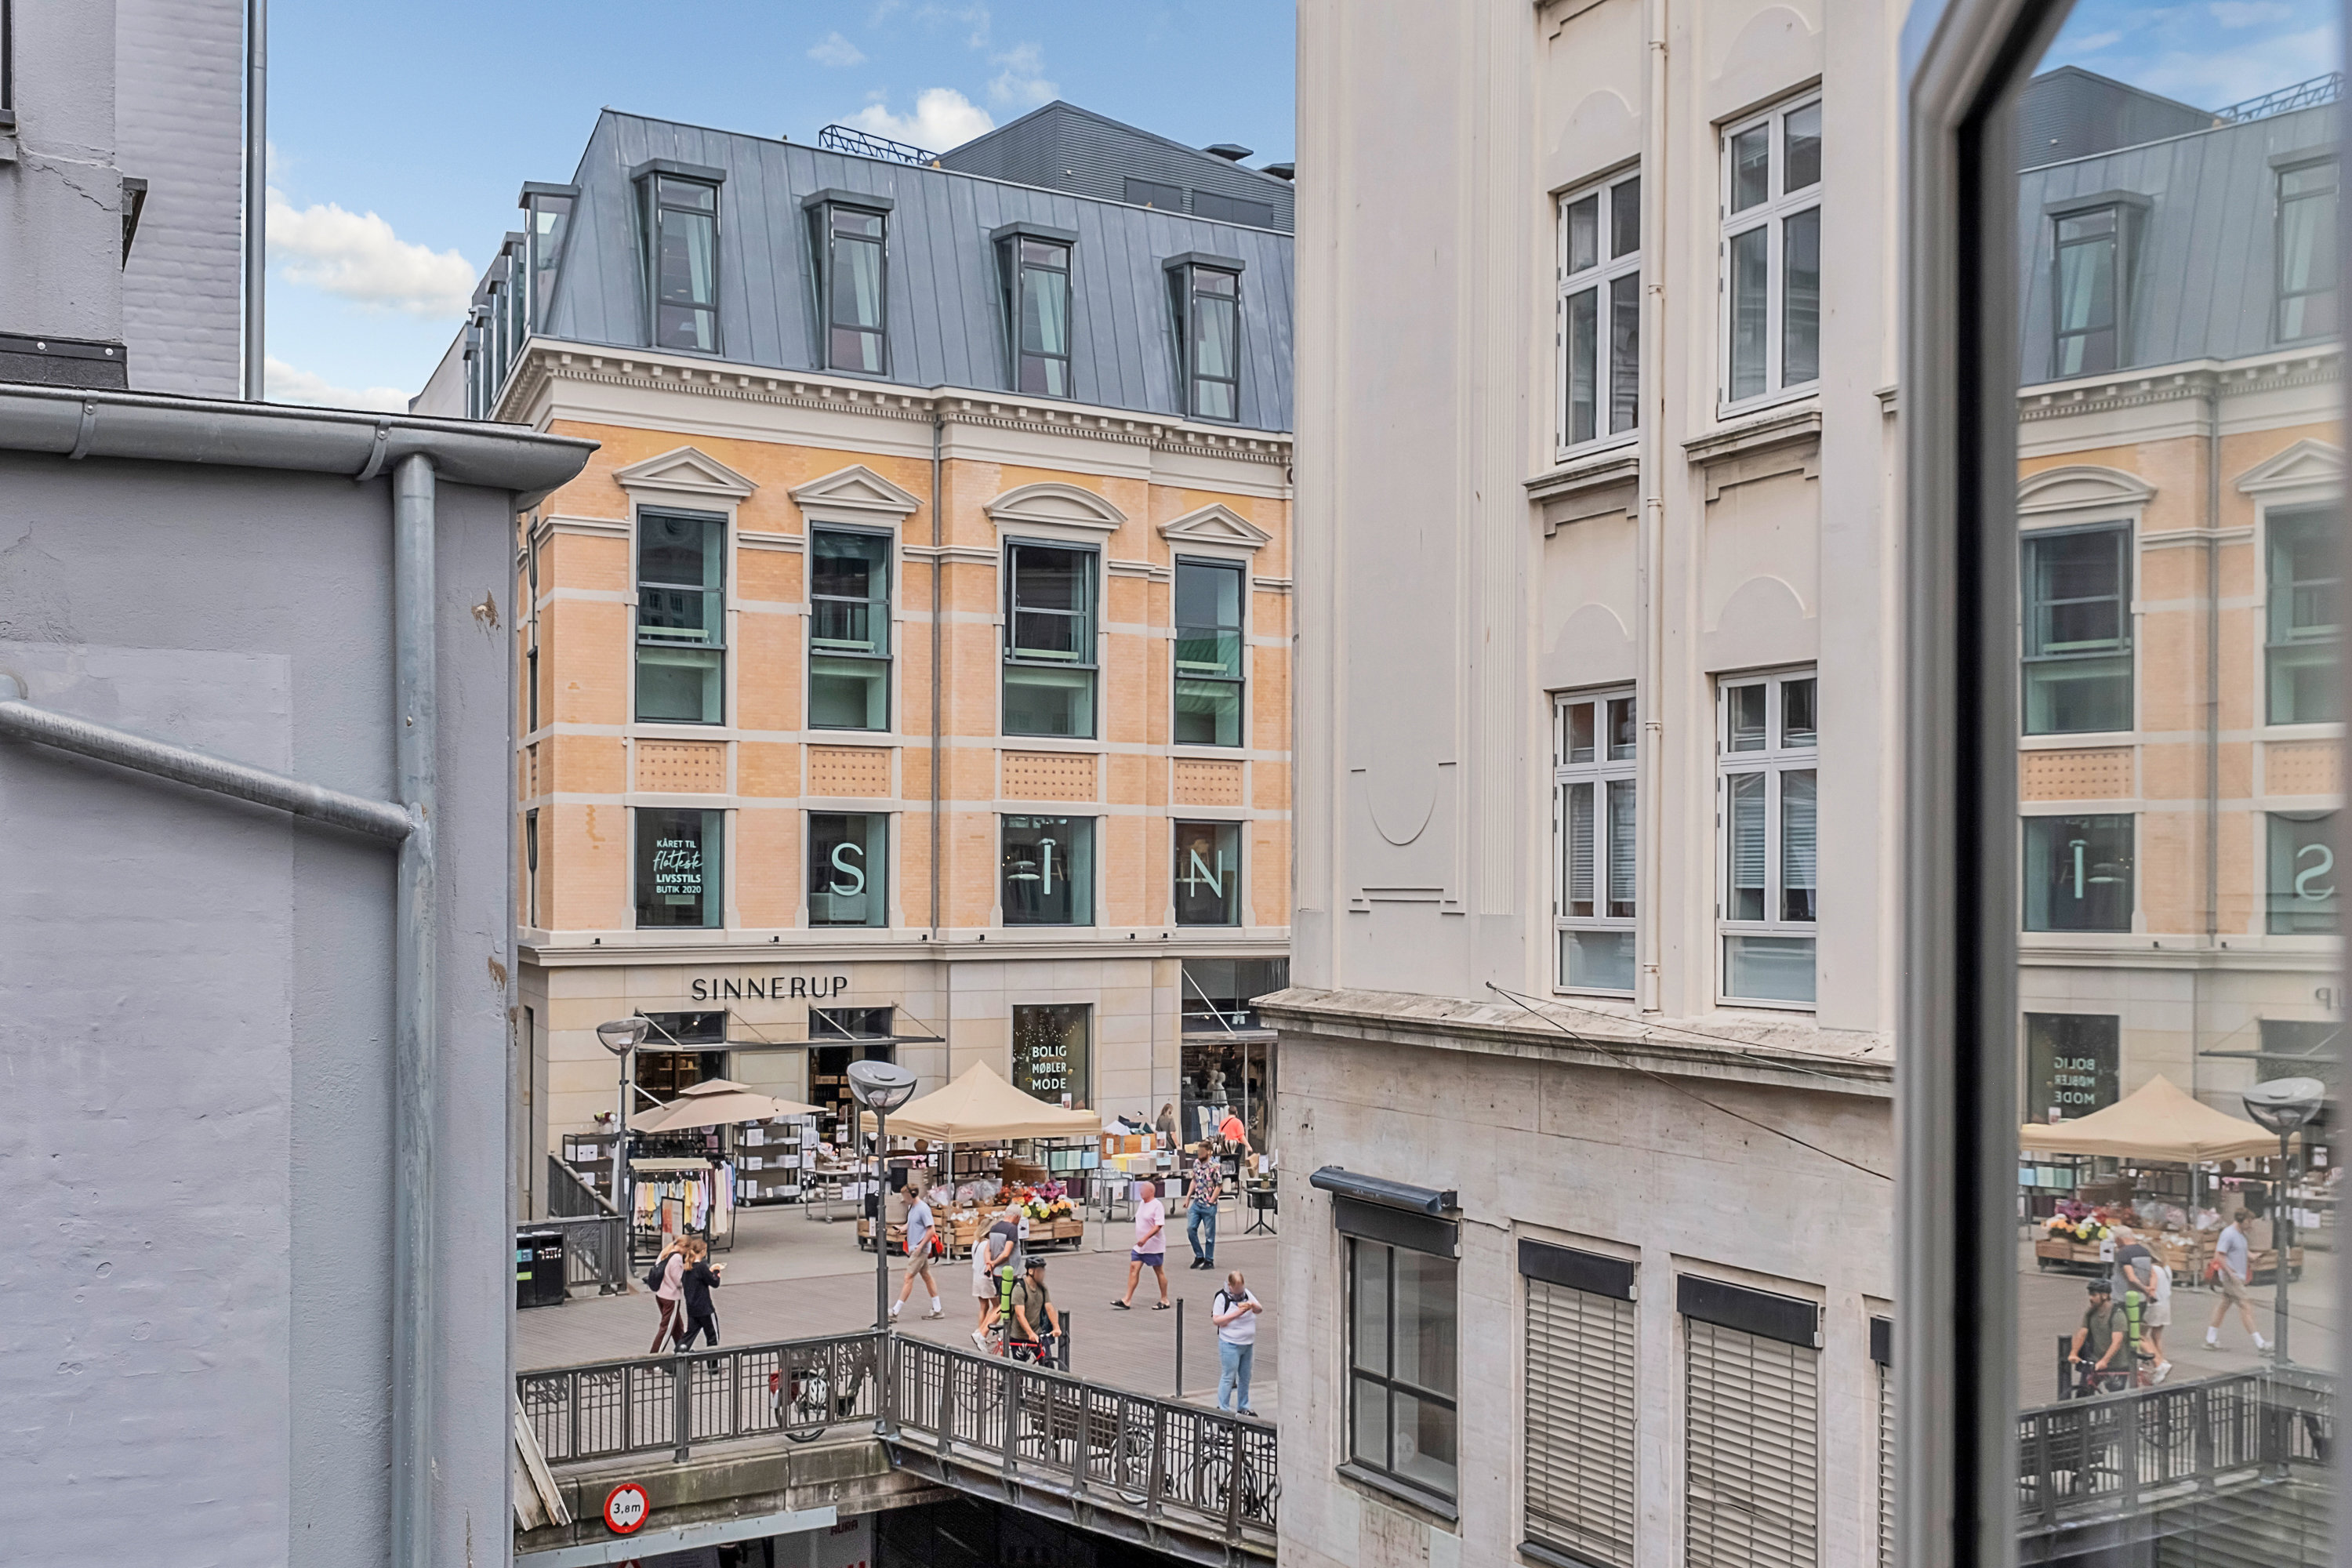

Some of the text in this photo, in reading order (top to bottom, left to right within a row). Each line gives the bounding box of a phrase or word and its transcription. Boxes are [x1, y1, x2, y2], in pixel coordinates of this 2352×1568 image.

[656, 837, 697, 848] KÅRET TIL
[652, 849, 703, 873] flotteste
[829, 842, 865, 896] S
[1190, 848, 1222, 898] N
[656, 873, 702, 884] LIVSSTILS
[656, 885, 702, 894] BUTIK 2020
[691, 976, 848, 1001] SINNERUP
[1032, 1045, 1067, 1058] BOLIG
[1032, 1062, 1067, 1074] MØBLER
[1032, 1078, 1067, 1091] MODE
